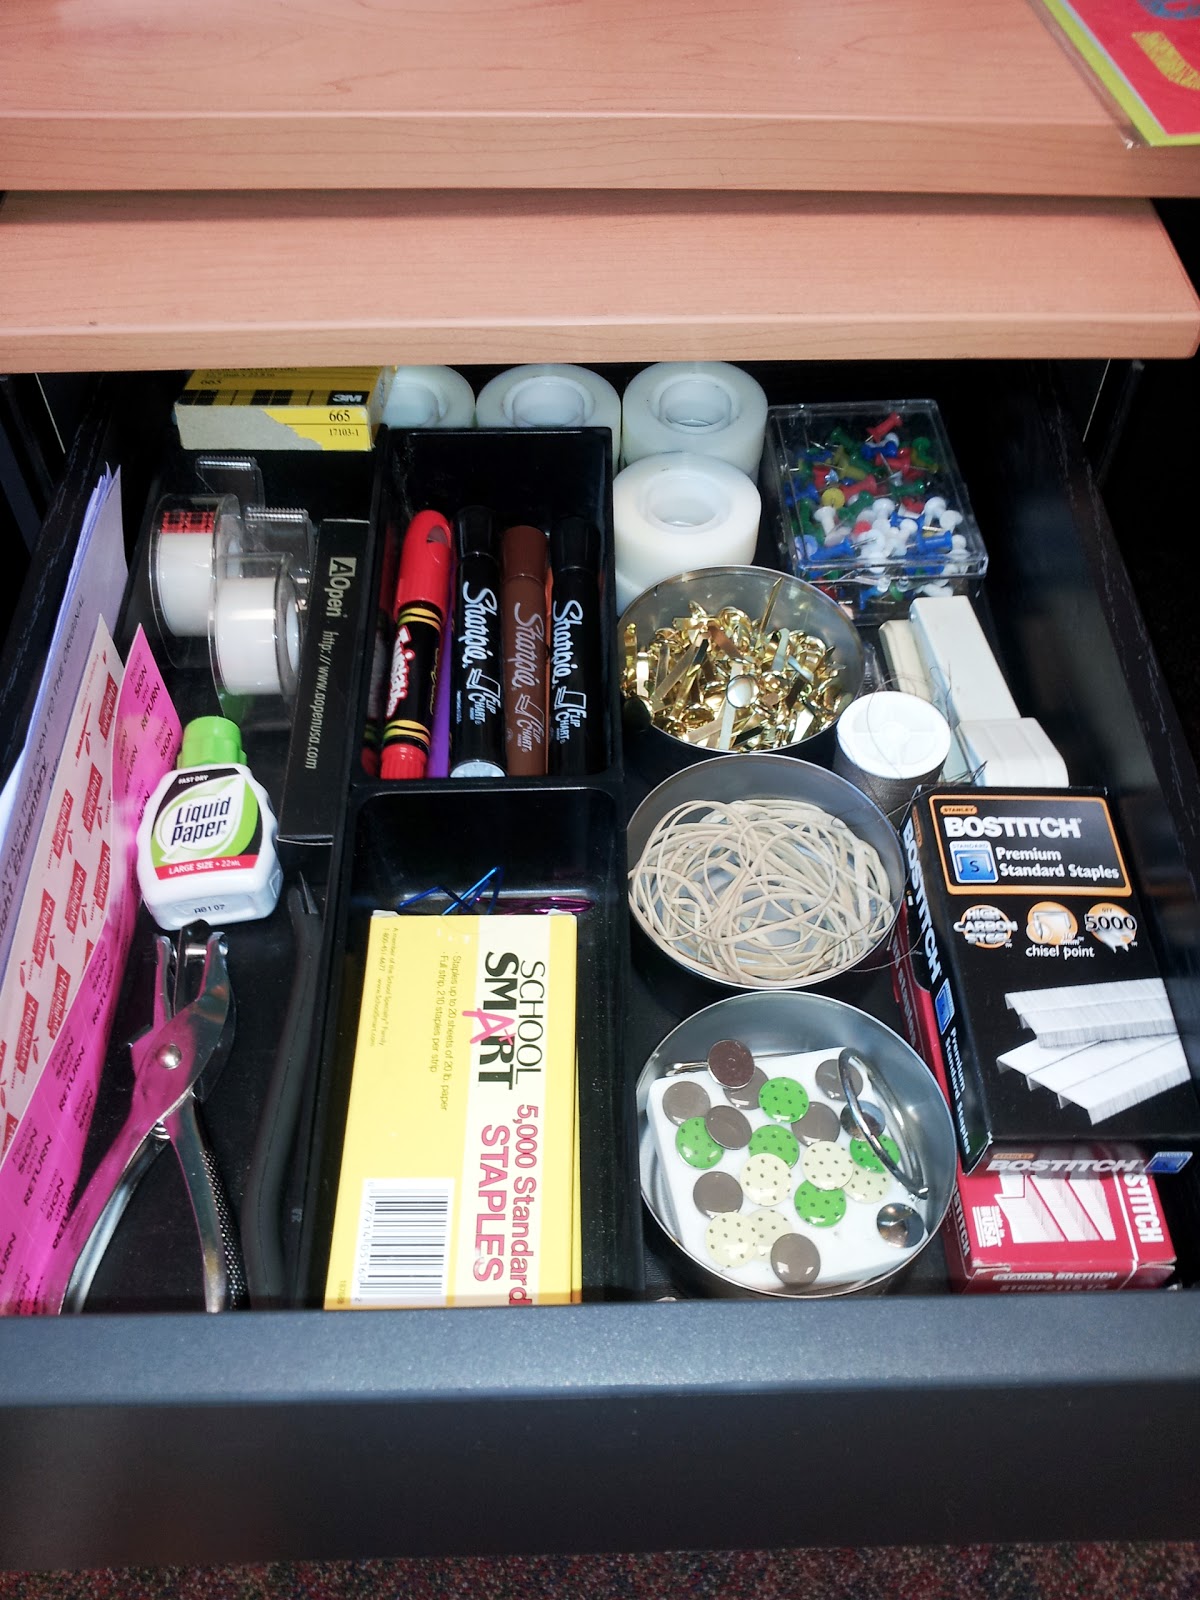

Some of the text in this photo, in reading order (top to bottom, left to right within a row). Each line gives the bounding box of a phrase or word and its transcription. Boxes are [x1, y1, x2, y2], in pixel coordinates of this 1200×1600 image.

[332, 394, 363, 403] 3M
[329, 409, 350, 422] 665
[329, 428, 359, 437] 17103-1
[323, 557, 357, 617] AOpen
[458, 581, 498, 669] Sharpie
[507, 602, 545, 689] Sharpie
[552, 599, 584, 686] Sharpie
[134, 664, 148, 699] SIGN
[141, 681, 161, 731] RETURN
[468, 692, 486, 724] CHART
[485, 692, 501, 714] FLIP
[555, 711, 570, 741] CHART
[569, 708, 587, 728] FLIP
[160, 727, 174, 761] SIGN
[517, 719, 532, 752] CHART
[531, 722, 545, 744] FLIP
[14, 762, 47, 876] Elementary
[175, 797, 232, 825] Liquid
[944, 816, 1082, 838] BOSTITCH
[168, 861, 195, 875] LARGE
[196, 860, 214, 871] SIZE
[969, 860, 979, 873] S
[995, 846, 1062, 861] Premium
[999, 863, 1120, 881] Standard Staples
[902, 817, 942, 983] BOSTITCH
[966, 907, 1002, 920] HIGH
[953, 920, 1018, 933] CARBON
[440, 955, 449, 968] Full
[1025, 944, 1095, 960] chisel point
[451, 955, 461, 985] Staples
[436, 990, 445, 1005] 210
[448, 986, 457, 996] up
[449, 997, 457, 1007] to
[434, 1006, 443, 1036] staples
[448, 1008, 457, 1019] 20
[462, 951, 520, 1090] SMART
[515, 960, 546, 1085] SCHOOL
[432, 1037, 440, 1052] per
[445, 1020, 456, 1048] sheets
[429, 1054, 439, 1073] strip
[443, 1061, 453, 1072] 20
[445, 1049, 453, 1059] of
[950, 1027, 966, 1092] Premium
[58, 1045, 86, 1112] RETURN
[440, 1085, 449, 1111] paper
[945, 1036, 971, 1155] Standard Staples
[18, 1128, 38, 1175] SIGN
[23, 1135, 53, 1206] RETURN
[986, 1159, 1139, 1173] BOSTITCH
[46, 1177, 65, 1222] SIGN
[473, 1124, 511, 1282] STAPLES
[509, 1104, 539, 1305] 5,000 Standard
[1123, 1173, 1165, 1243] STITCH
[954, 1186, 970, 1256] STITCH
